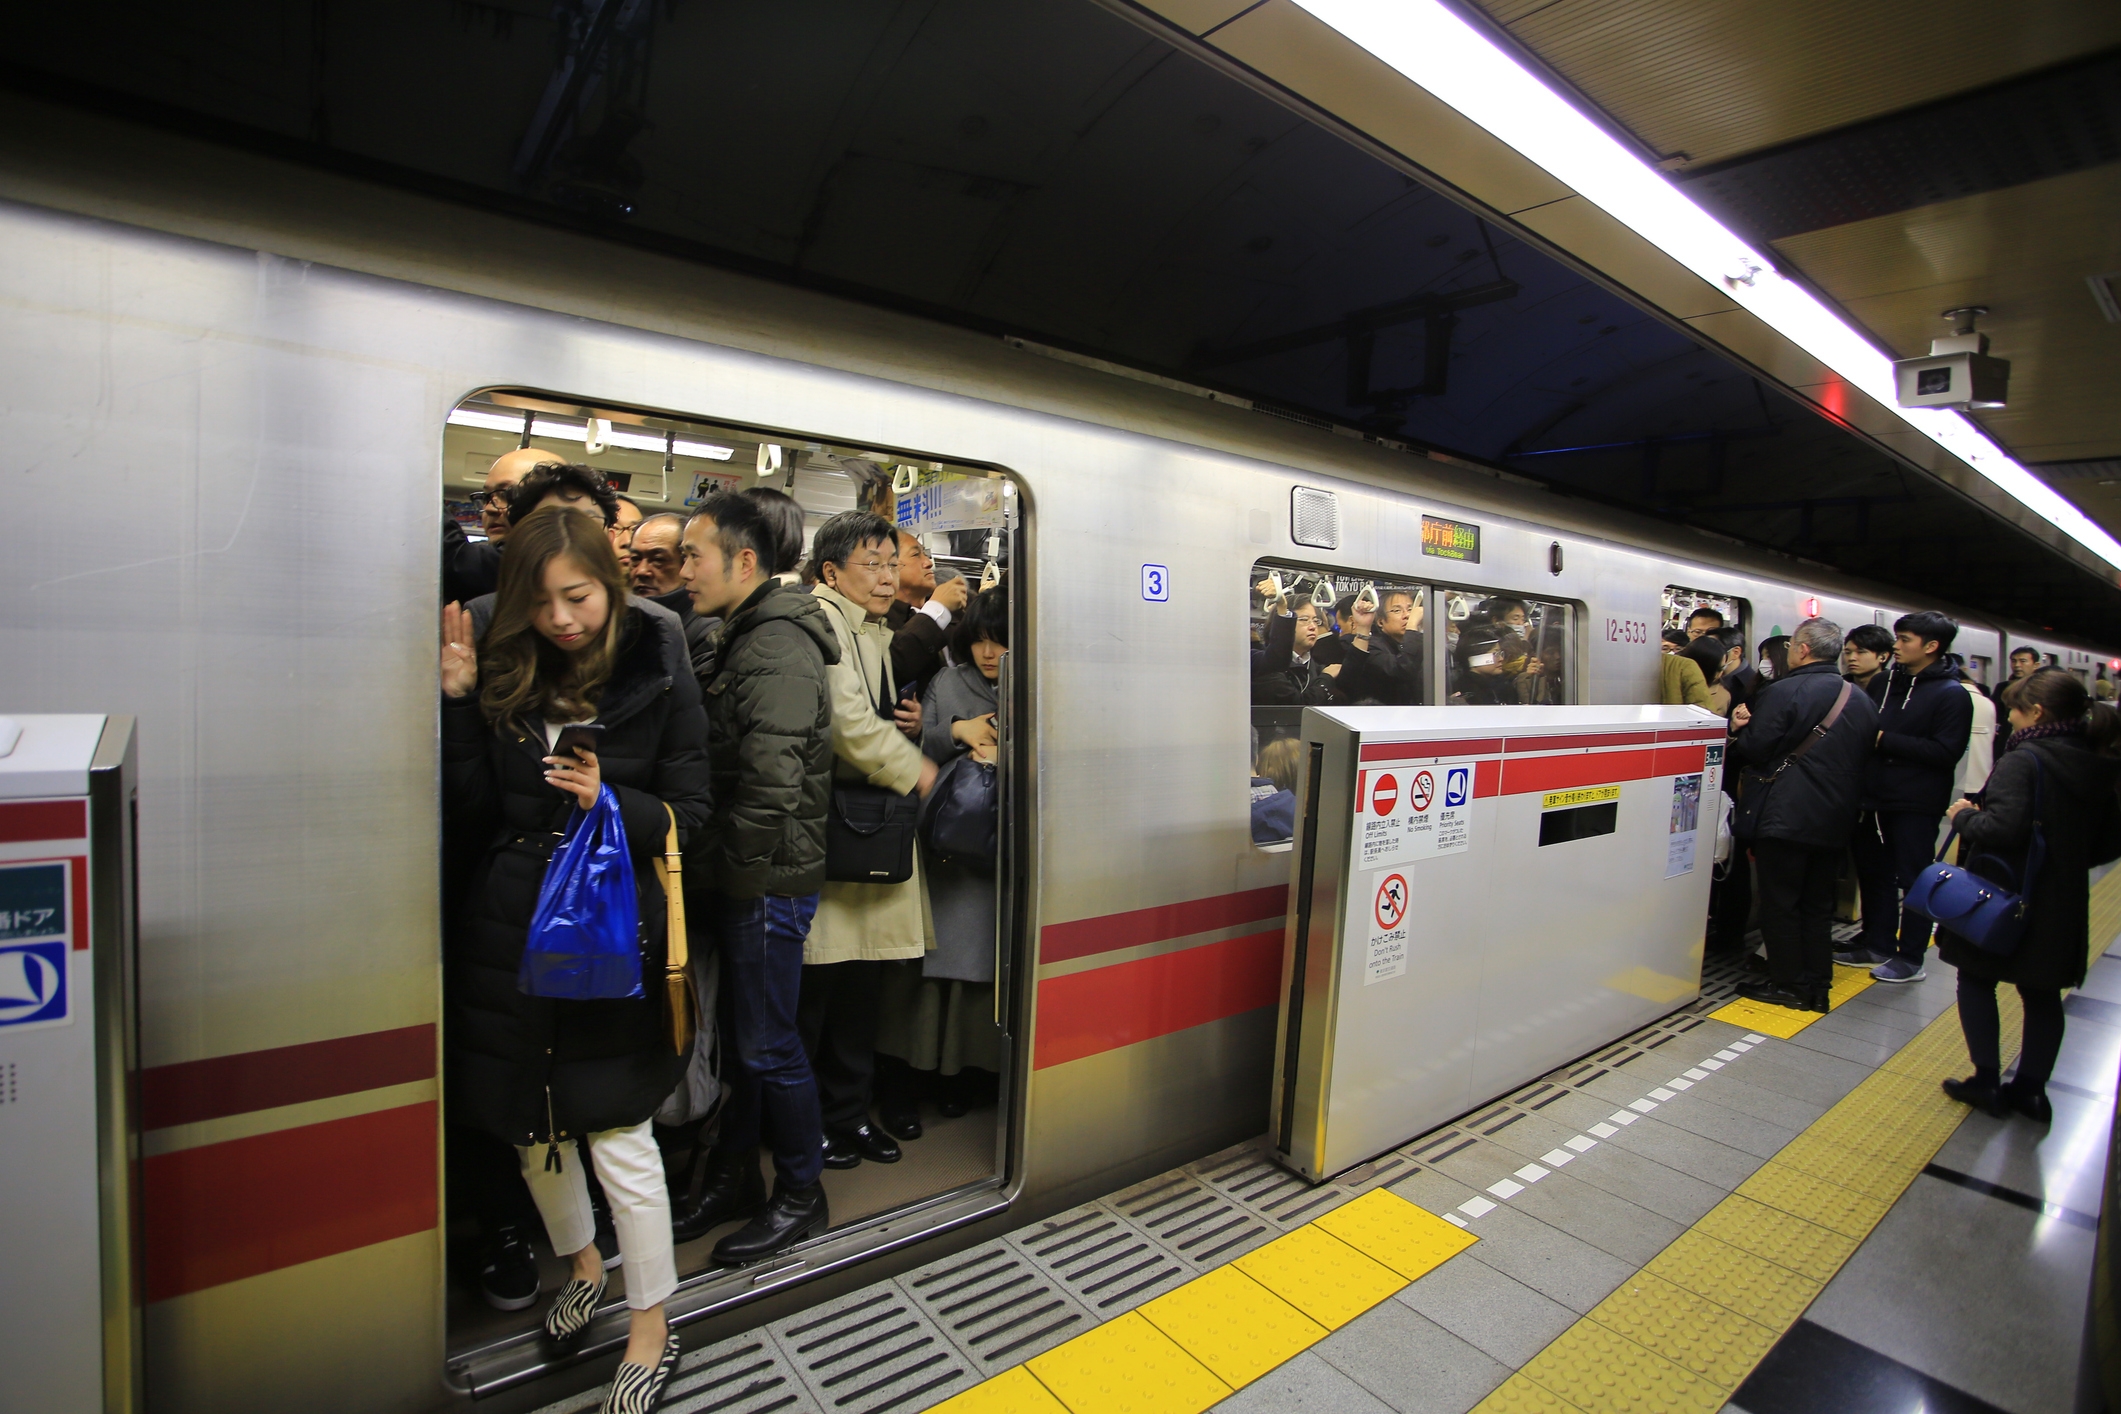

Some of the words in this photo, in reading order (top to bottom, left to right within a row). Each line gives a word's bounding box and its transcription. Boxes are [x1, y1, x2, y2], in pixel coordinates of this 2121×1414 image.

[1422, 520, 1475, 551] 都庁前経由
[1425, 545, 1435, 555] via
[1149, 571, 1162, 595] 3
[1335, 581, 1358, 592] TOKYO
[1606, 618, 1647, 645] 12-533
[1440, 811, 1455, 821] 優先席
[1365, 818, 1400, 831] 線路内立入禁止
[1414, 824, 1432, 832] Smoking
[1439, 821, 1453, 829] Priority
[1371, 929, 1406, 947] かけこみ禁止
[1374, 947, 1388, 957] Don't
[1389, 943, 1401, 953] Rush
[1369, 960, 1381, 969] onto
[1382, 957, 1391, 965] the
[1392, 953, 1404, 962] Train
